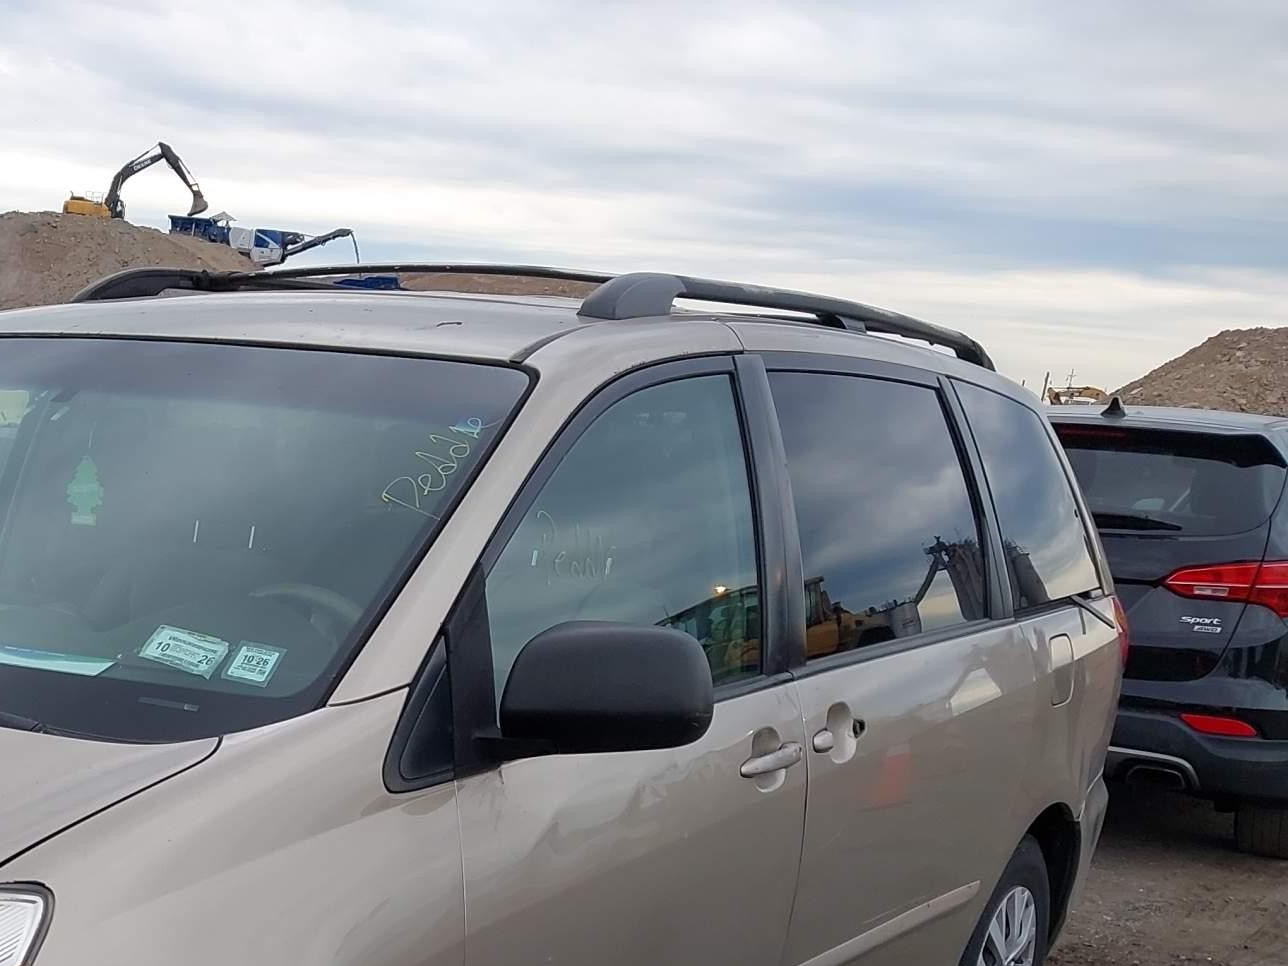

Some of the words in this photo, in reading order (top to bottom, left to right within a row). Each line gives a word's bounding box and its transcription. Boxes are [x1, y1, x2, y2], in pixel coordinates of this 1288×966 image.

[1179, 616, 1222, 625] Sport
[155, 641, 171, 653] 10
[197, 654, 216, 666] 26
